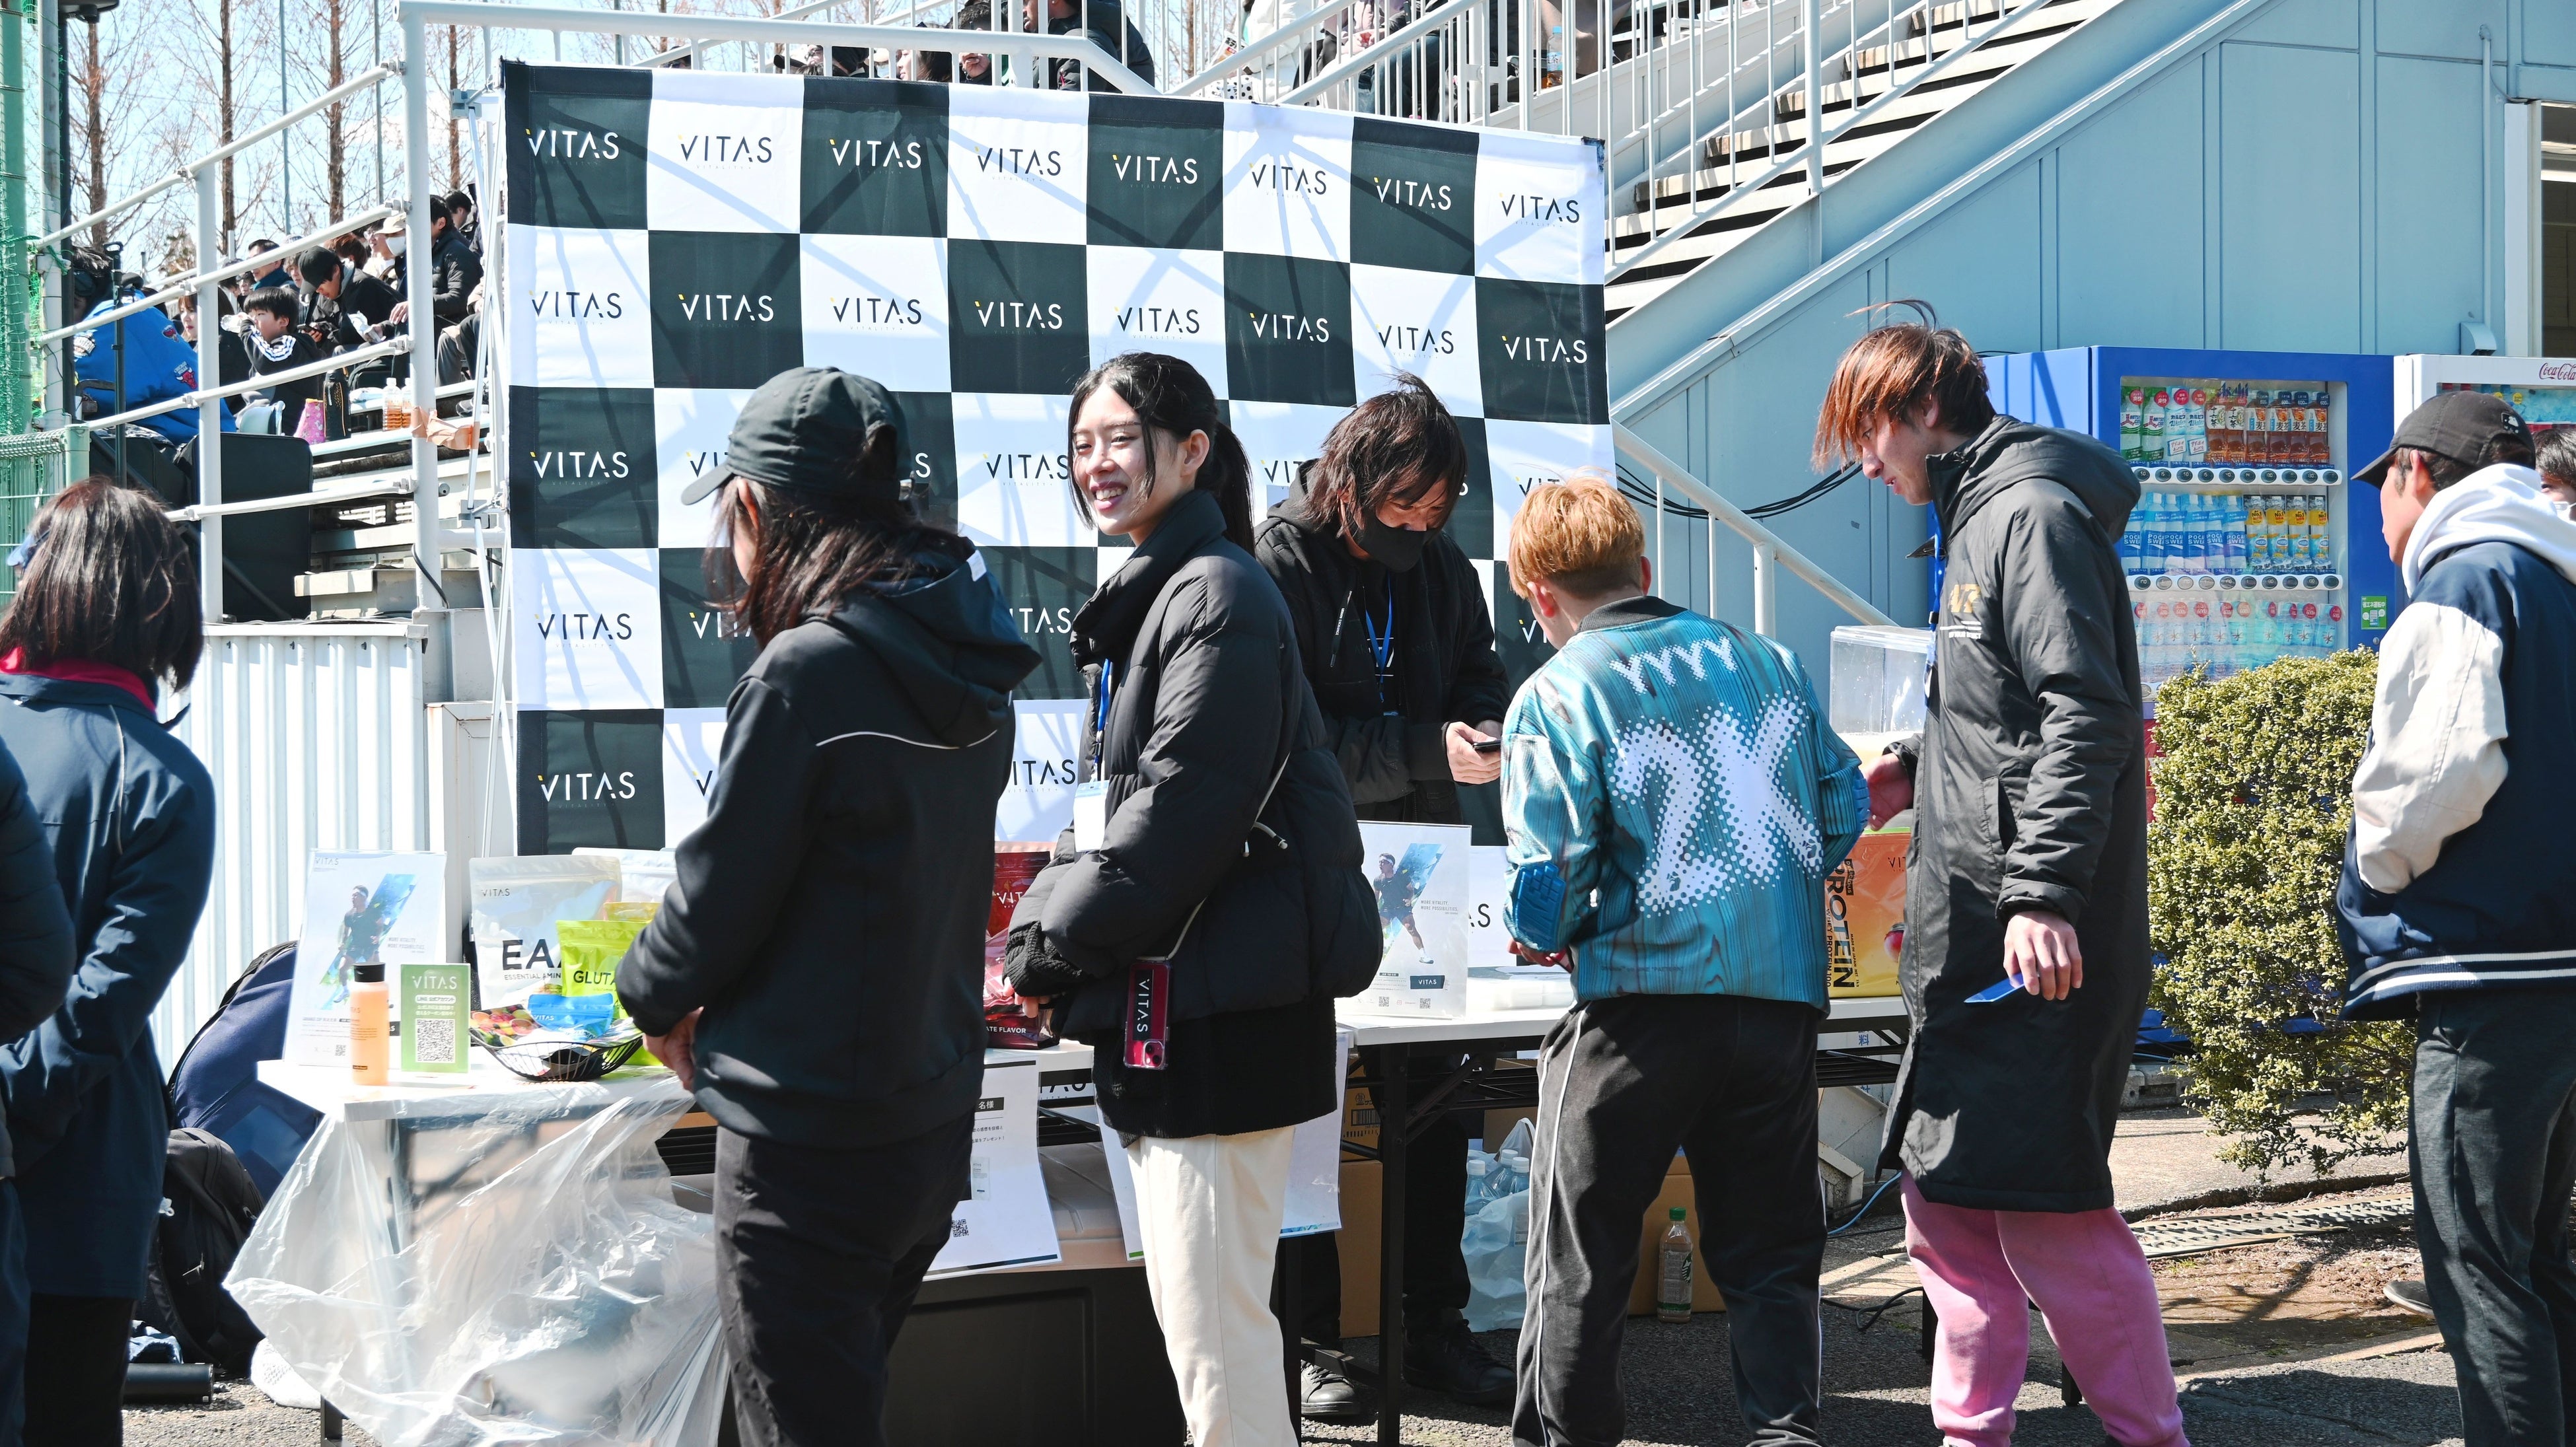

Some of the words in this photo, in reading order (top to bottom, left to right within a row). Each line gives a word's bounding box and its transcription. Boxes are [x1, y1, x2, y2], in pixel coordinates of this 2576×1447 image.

[526, 129, 620, 160] VITAS
[678, 135, 772, 164] VITAS
[830, 138, 921, 169] VITAS
[975, 146, 1061, 176] VITAS
[1112, 154, 1198, 185] VITAS
[1249, 162, 1327, 195] VITAS
[1375, 177, 1452, 211] VITAS
[1499, 192, 1581, 224] VITAS
[528, 290, 622, 319] VITAS
[678, 294, 773, 322] VITAS
[830, 297, 921, 325] VITAS
[975, 300, 1063, 330] VITAS
[1114, 306, 1200, 334] VITAS
[1250, 312, 1329, 343] VITAS
[1376, 324, 1454, 355] VITAS
[1501, 335, 1588, 365] VITAS
[2539, 363, 2576, 380] Coca-Cola
[2210, 407, 2219, 428] 十六茶
[2229, 407, 2238, 428] 十六茶
[2293, 421, 2306, 431] 麦茶
[530, 452, 629, 479] VITAS
[983, 454, 1069, 479] VITAS
[534, 613, 632, 641] VITAS
[1009, 607, 1071, 633] TAS
[1610, 635, 1737, 695] YYYY
[538, 772, 635, 801] VITAS
[1013, 759, 1075, 785] ITAS
[1636, 690, 1823, 919] 2K
[997, 892, 1022, 904] VIT
[503, 938, 561, 971] EA
[412, 976, 457, 990] VITAS
[1137, 979, 1150, 1032] VITAS
[979, 1101, 994, 1110] 名様
